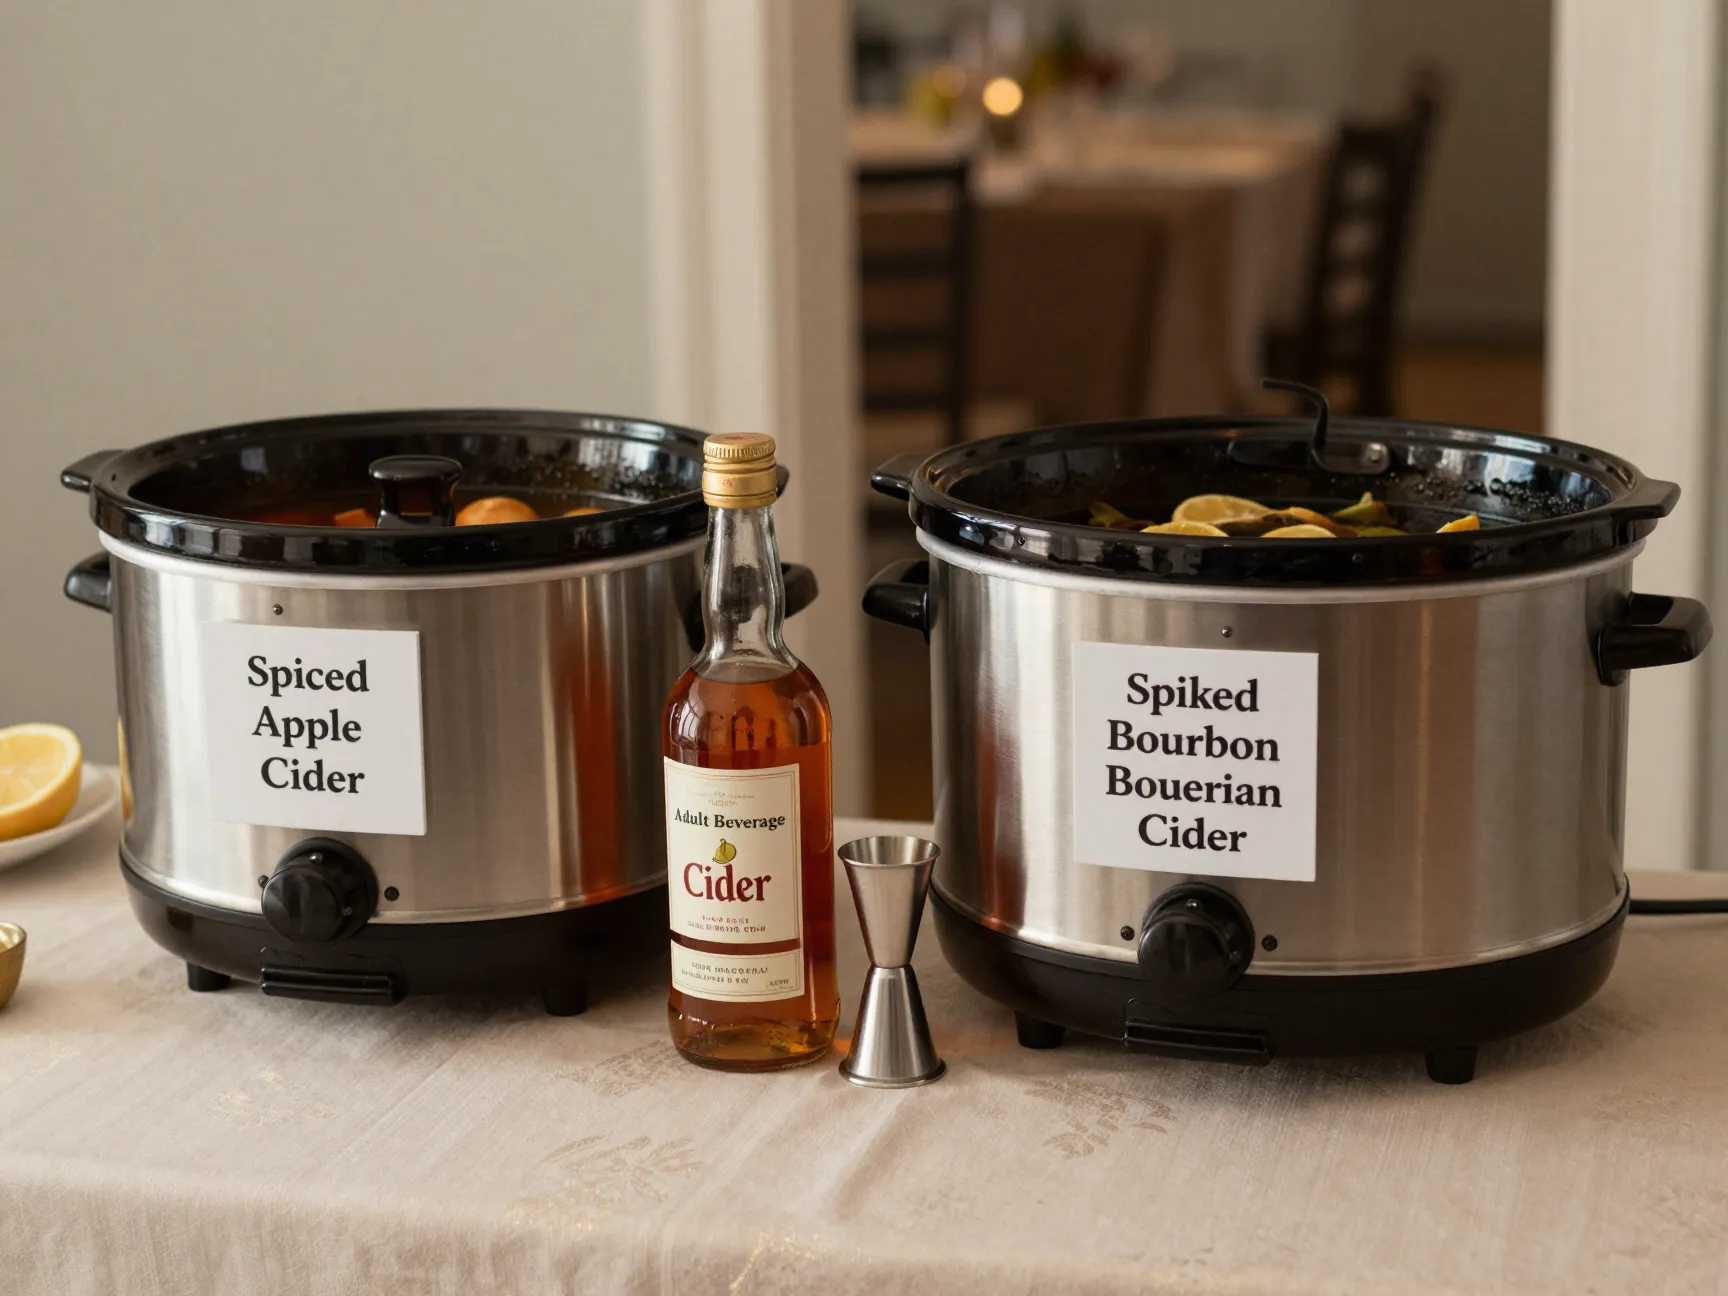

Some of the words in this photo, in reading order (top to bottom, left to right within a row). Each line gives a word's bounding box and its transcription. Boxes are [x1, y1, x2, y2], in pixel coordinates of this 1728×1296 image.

[247, 655, 370, 697] Spiced
[1126, 672, 1260, 716] Spiked
[251, 705, 362, 750] Apple
[1107, 719, 1281, 762] Bourbon
[260, 756, 365, 794] Cider
[1105, 764, 1283, 808] Bouerian
[675, 808, 709, 827] Adult
[714, 814, 786, 831] Beverage
[1138, 813, 1248, 853] Cider
[683, 862, 772, 902] Cider
